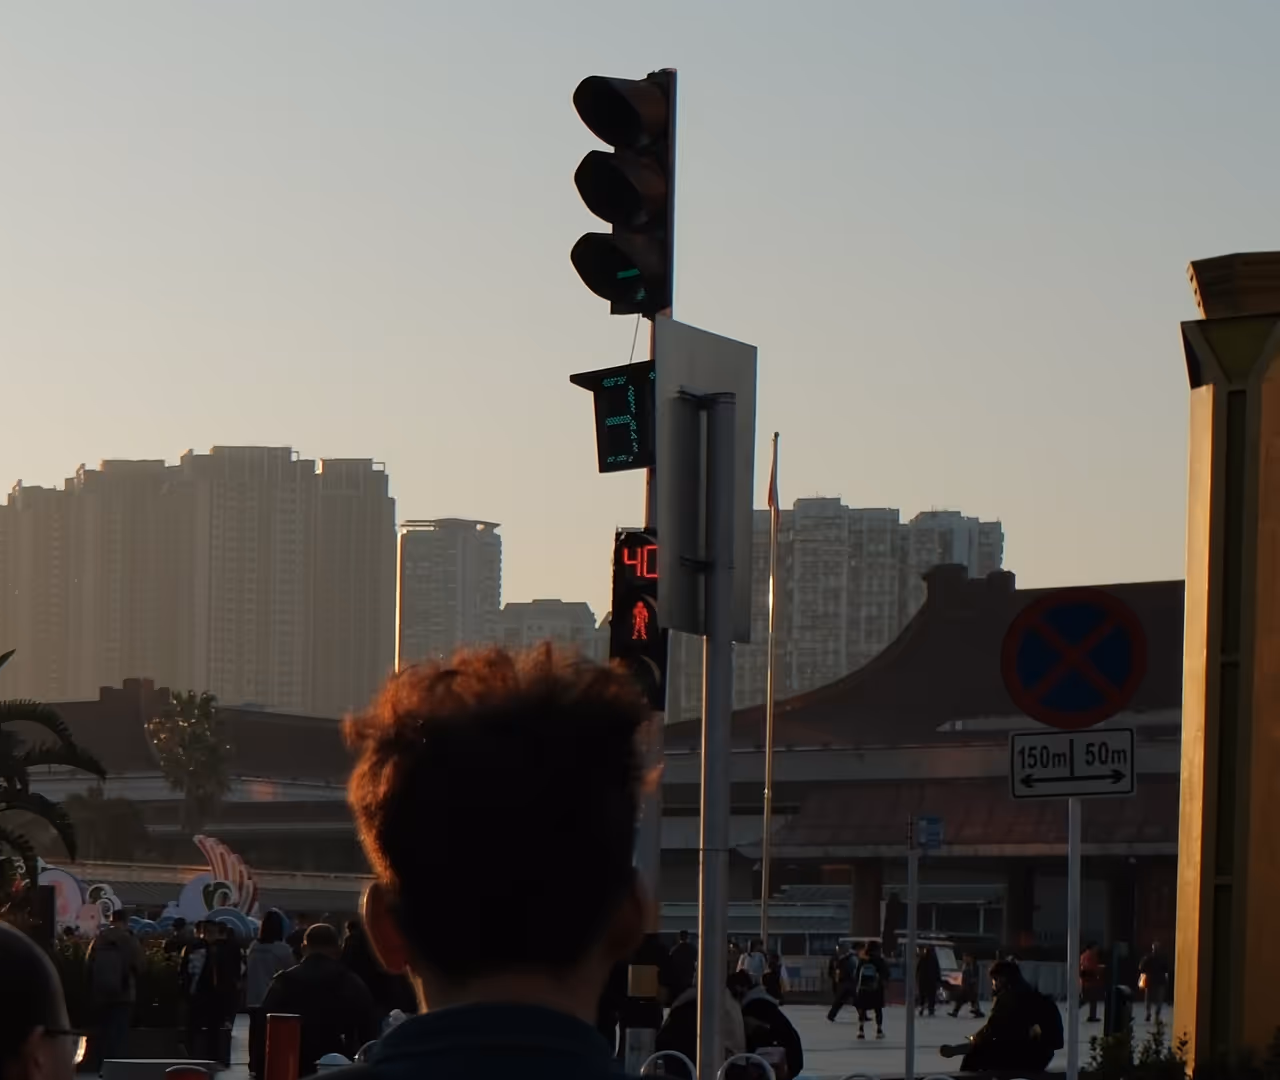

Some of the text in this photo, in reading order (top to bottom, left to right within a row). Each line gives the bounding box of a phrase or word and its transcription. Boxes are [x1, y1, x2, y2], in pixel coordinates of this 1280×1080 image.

[602, 372, 656, 463] 3
[624, 545, 658, 577] 40
[1018, 742, 1127, 769] 150m 50m
